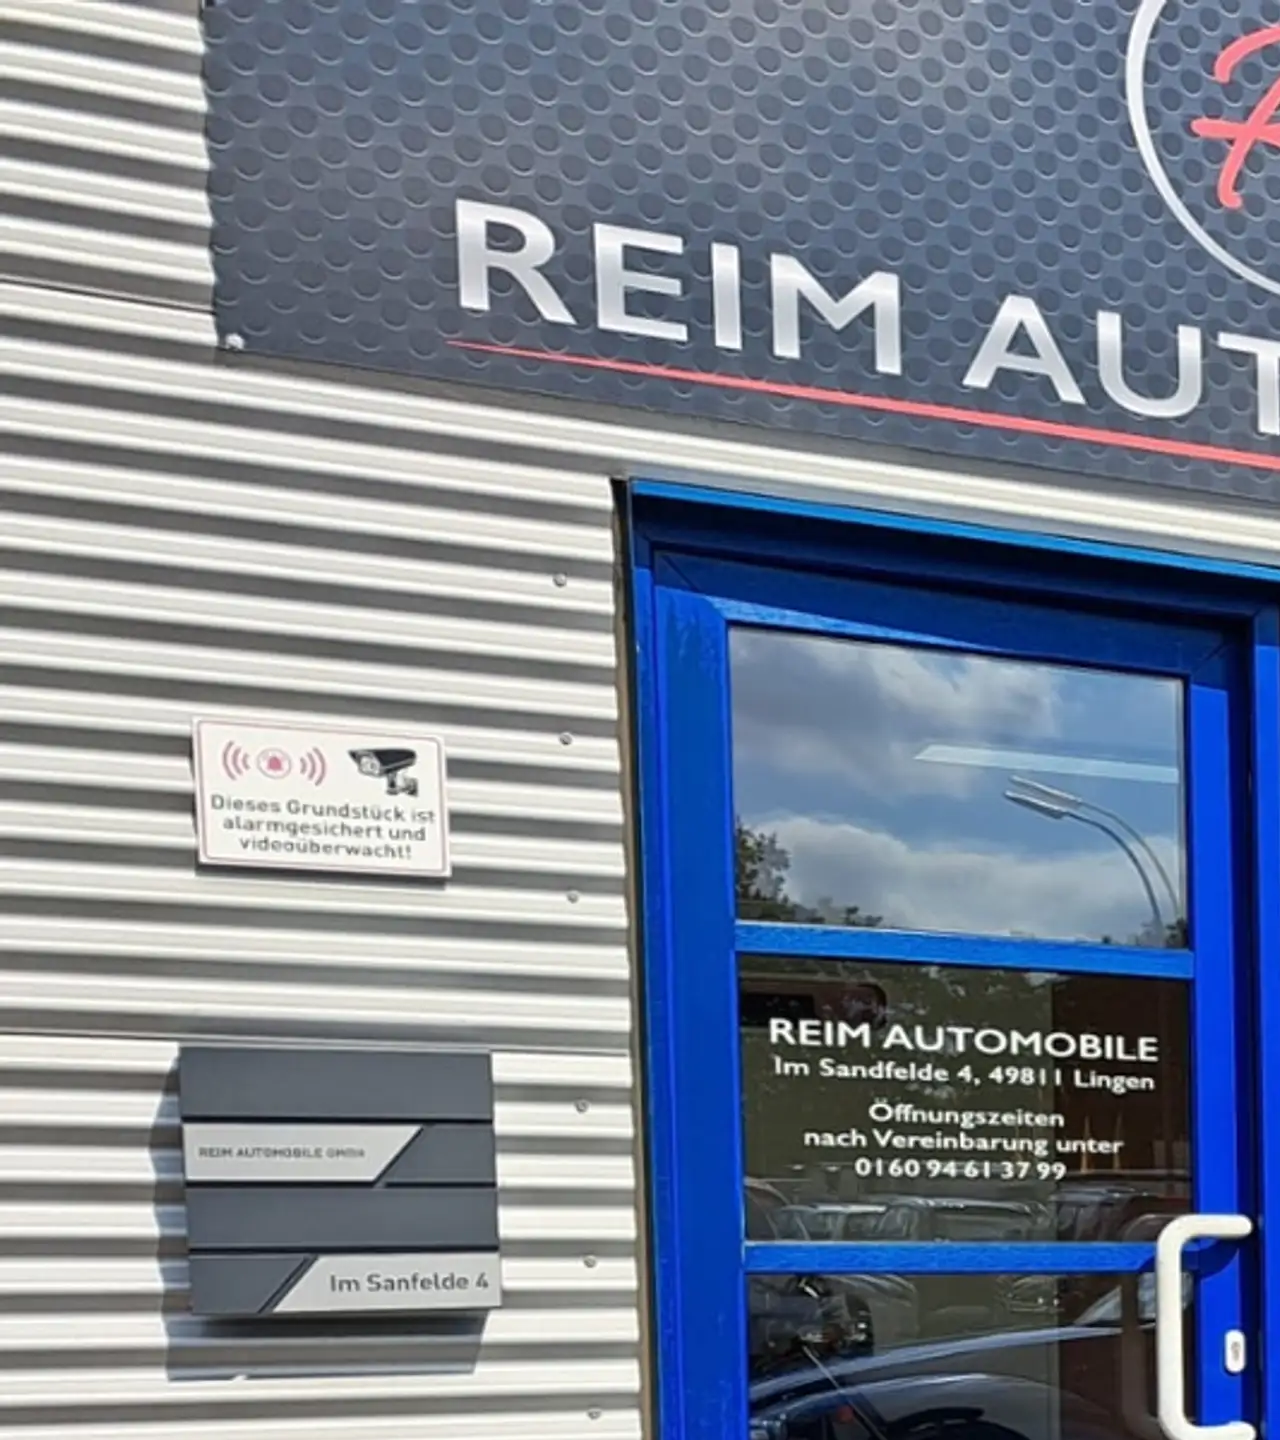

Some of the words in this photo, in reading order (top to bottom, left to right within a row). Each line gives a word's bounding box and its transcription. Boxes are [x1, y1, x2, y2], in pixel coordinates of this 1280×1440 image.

[454, 198, 903, 376] REIM
[210, 794, 281, 814] Dieses
[286, 798, 406, 823] Grundstück
[410, 808, 436, 824] ist
[222, 815, 384, 840] alarmgesichert
[388, 826, 426, 842] und
[239, 835, 413, 861] videoüberwacht!
[768, 1017, 871, 1048] REIM
[882, 1023, 1159, 1063] AUTOMOBILE
[774, 1055, 810, 1077] Im
[818, 1056, 949, 1083] Sandfelde
[957, 1065, 981, 1087] 4,
[988, 1066, 1063, 1087] 49811
[1073, 1069, 1155, 1096] Lingen
[868, 1098, 1065, 1131] Öffnungszeiten
[198, 1147, 232, 1159] REIM
[235, 1147, 323, 1159] AUTOMOBILE
[804, 1129, 867, 1149] nach
[872, 1129, 1048, 1157] Vereinbarung
[1055, 1136, 1124, 1155] unter
[854, 1156, 921, 1178] 0160
[330, 1274, 361, 1293] Im
[366, 1271, 469, 1293] Sanfelde
[474, 1271, 490, 1290] 4
